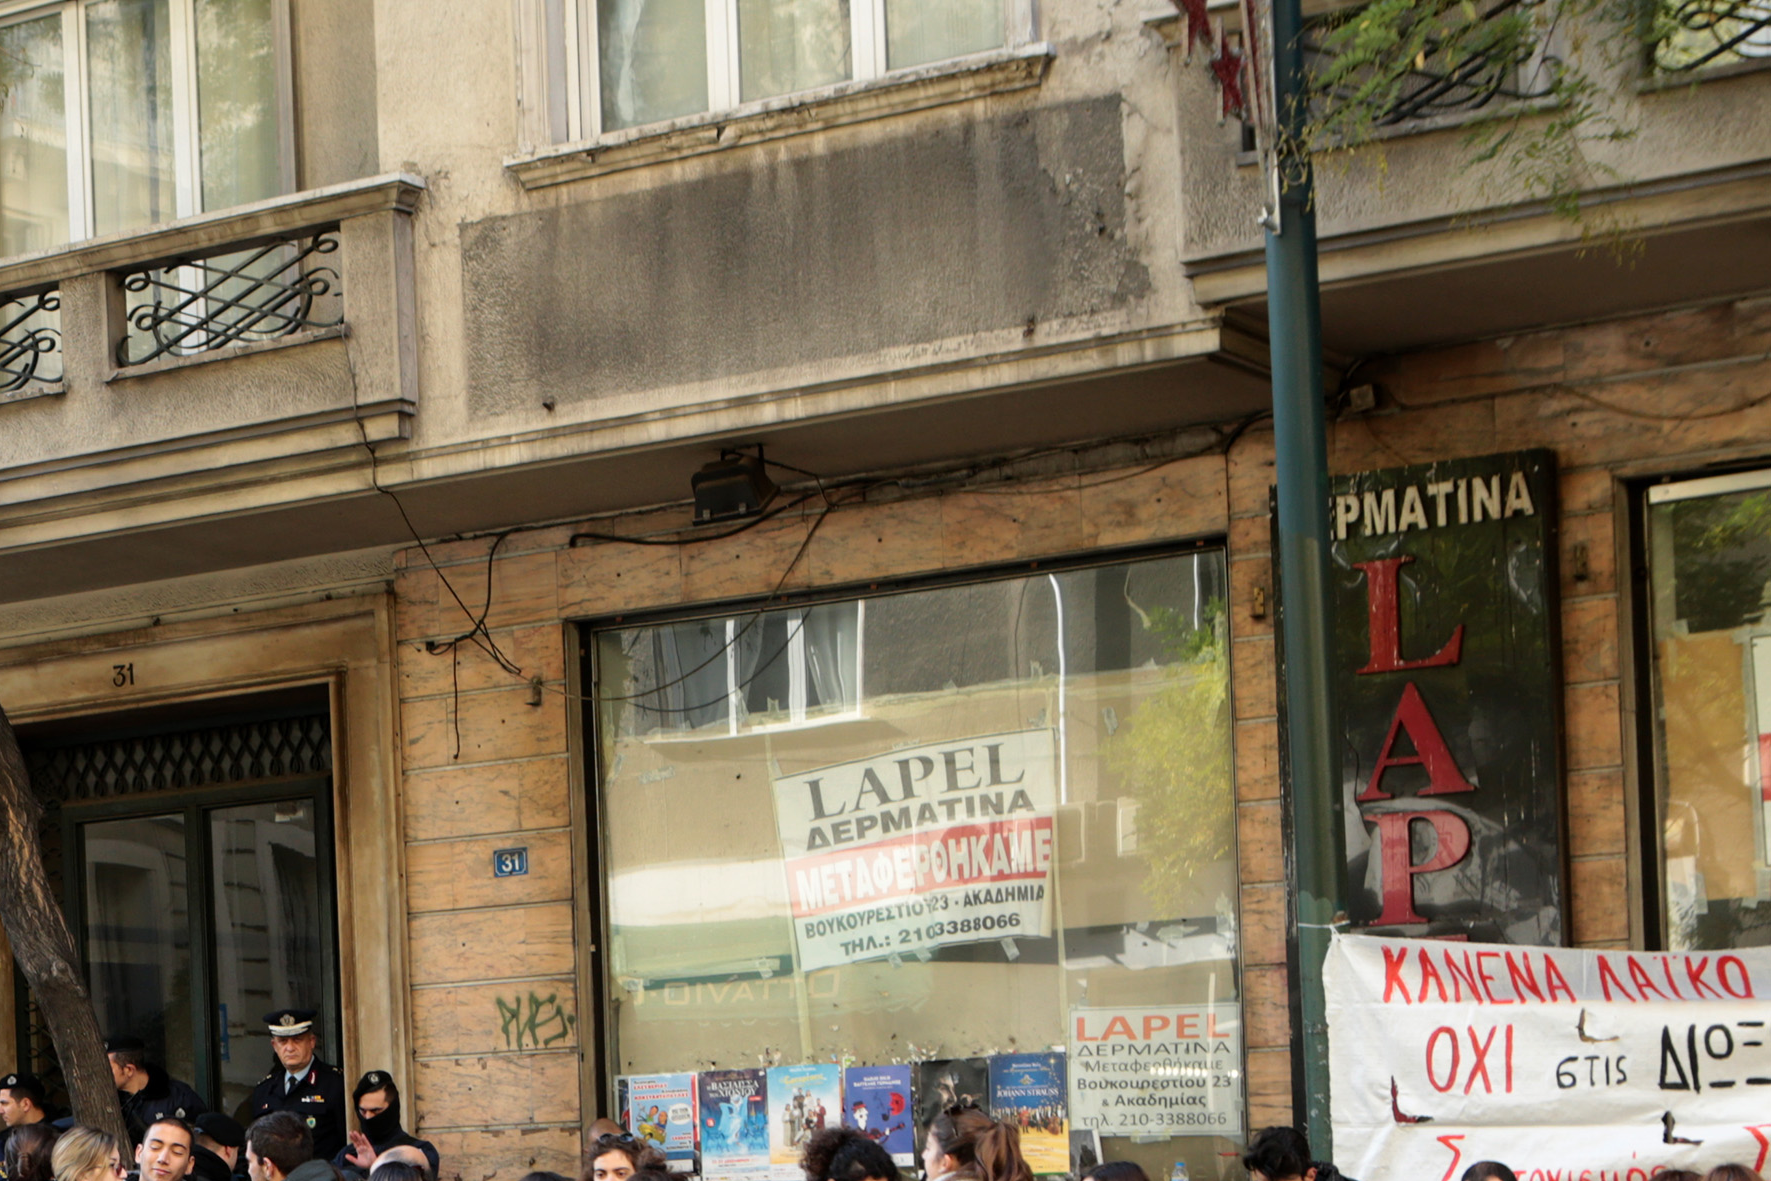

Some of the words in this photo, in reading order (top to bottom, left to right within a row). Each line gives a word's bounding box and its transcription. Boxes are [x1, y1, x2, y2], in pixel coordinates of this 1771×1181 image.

[1330, 470, 1535, 542] ΡΜΑΤΙΝΑ
[113, 663, 135, 687] 31
[1352, 555, 1476, 941] LAP
[803, 742, 1025, 822] LAPEL
[806, 789, 1036, 851] ΔΕΡΜΑΤΙΝΑ
[501, 853, 520, 873] 31
[796, 828, 1052, 911] ΜΕΤΑΦΕΡΘΗΚΑΜΕ
[840, 935, 891, 956] ΤΗΛ.:
[1381, 945, 1577, 1006] ΚΑΝΕΝΑ
[1076, 1013, 1231, 1042] LAPEL
[1078, 1041, 1231, 1057] ΔΕΡΜΑΤΙΝΑ
[1426, 1023, 1513, 1096] ΟΧΙ
[1077, 1075, 1206, 1091] Βουκουρεστίου
[1212, 1075, 1232, 1088] 23
[1115, 1092, 1206, 1108] Ακαδημίας
[1082, 1114, 1114, 1128] τηλ.
[1119, 1112, 1227, 1127] 210-3388066
